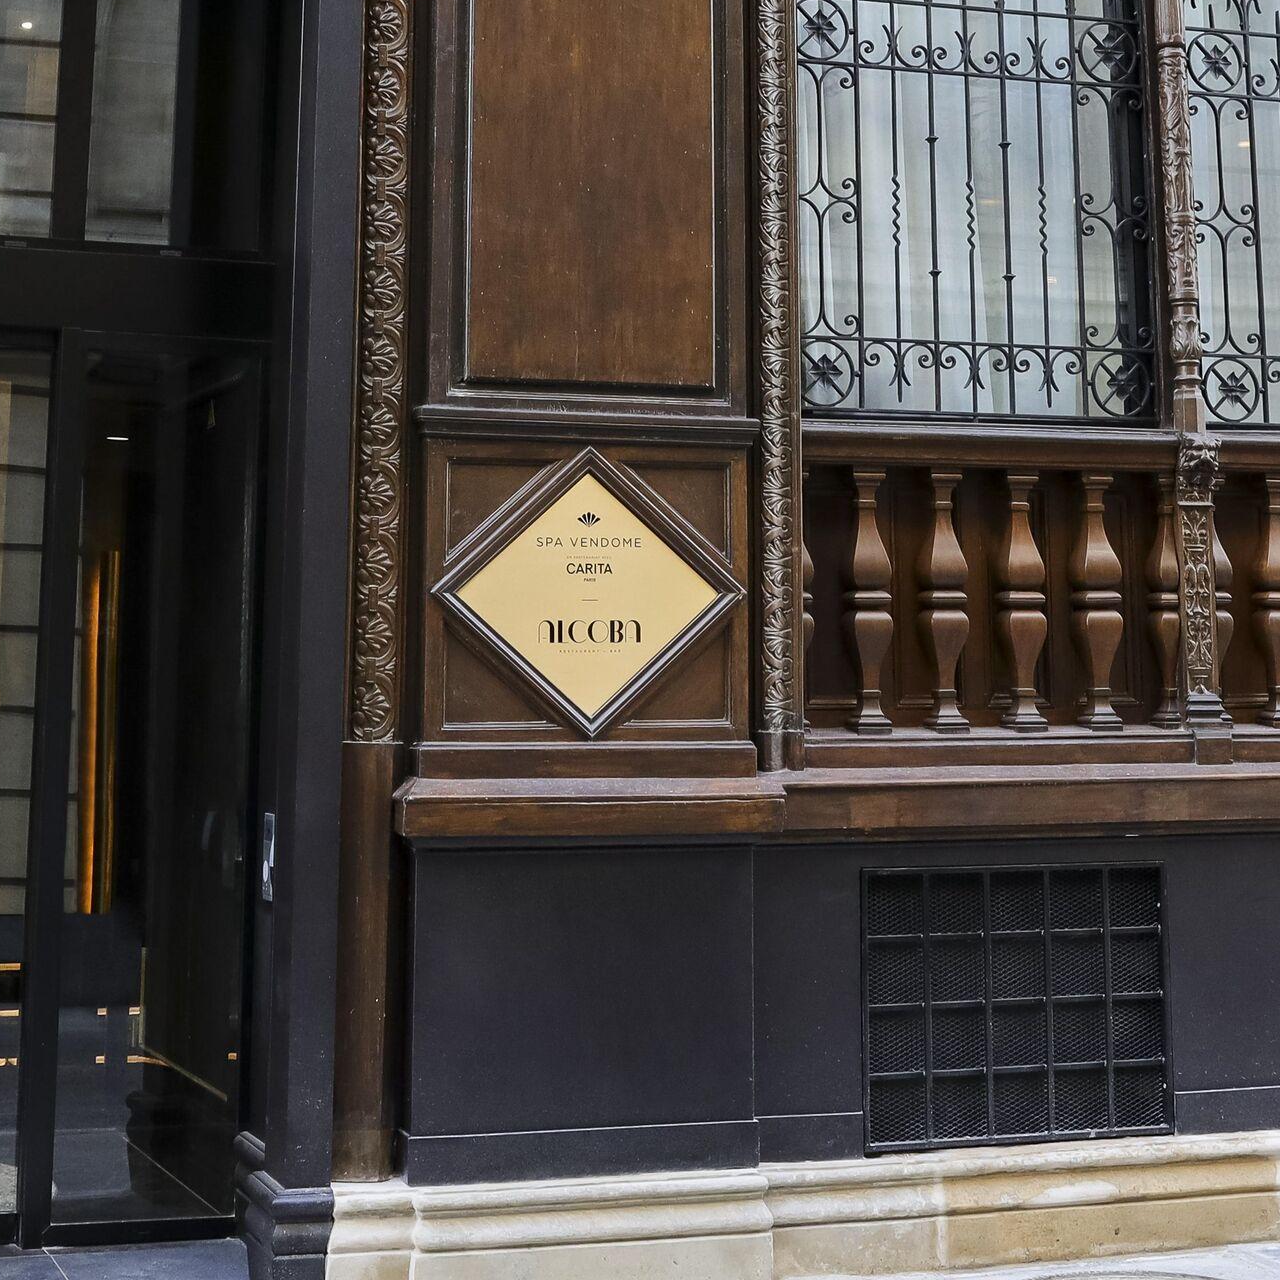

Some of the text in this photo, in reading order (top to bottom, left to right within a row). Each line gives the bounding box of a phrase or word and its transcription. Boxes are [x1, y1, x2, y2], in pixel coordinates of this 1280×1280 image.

[536, 536, 642, 548] SPA VENDOME
[566, 562, 613, 574] CARITA
[538, 619, 642, 644] ALCOBA
